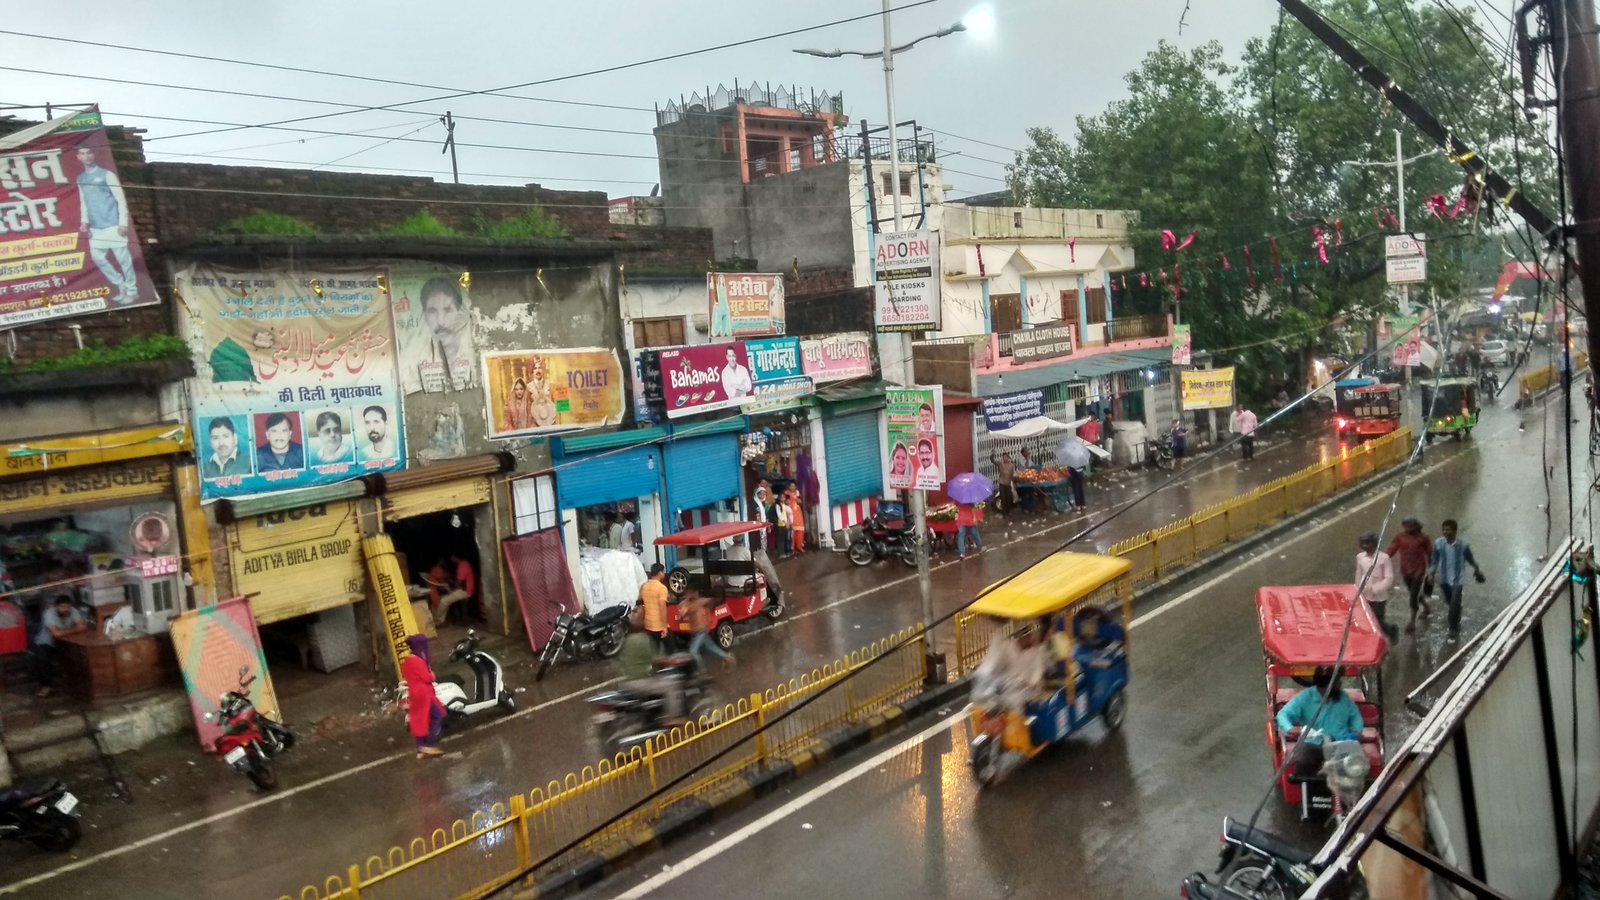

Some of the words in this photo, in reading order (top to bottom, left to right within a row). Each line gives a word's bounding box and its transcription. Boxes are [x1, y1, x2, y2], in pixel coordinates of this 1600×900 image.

[885, 233, 906, 241] CONTACT
[907, 232, 917, 240] FOR
[1388, 240, 1423, 250] ADOR
[877, 240, 929, 260] ADORN
[901, 282, 925, 290] KIOSKS
[888, 295, 922, 303] HOARDING
[1013, 331, 1035, 344] CHAWLA
[1036, 328, 1052, 340] CLOTH
[1053, 326, 1069, 337] HOUSE
[566, 369, 609, 389] TOILET
[670, 365, 720, 389] Bahamas
[331, 385, 383, 404] मुबारकबाद
[244, 551, 285, 575] ADITYA
[287, 546, 318, 567] BIRLA
[320, 539, 352, 559] GROUP
[377, 572, 397, 607] GROUP
[386, 606, 406, 641] BIRLA
